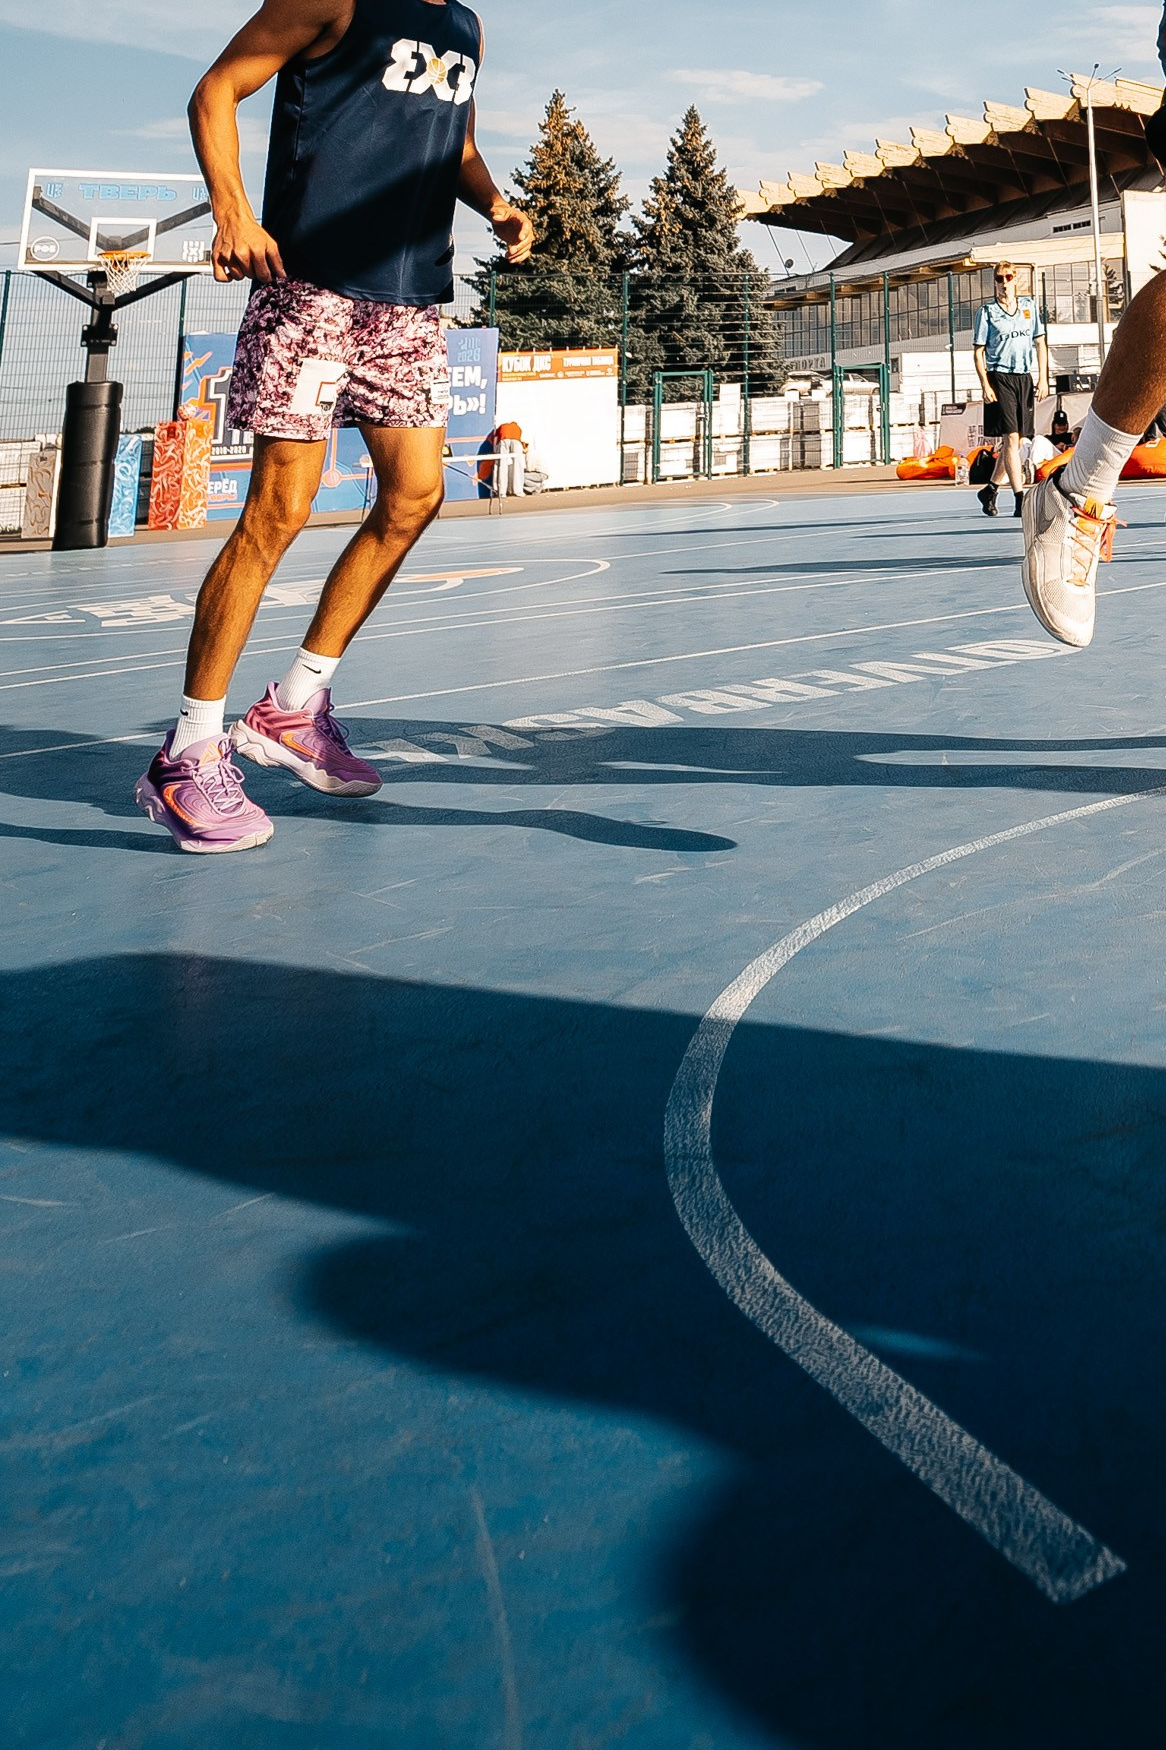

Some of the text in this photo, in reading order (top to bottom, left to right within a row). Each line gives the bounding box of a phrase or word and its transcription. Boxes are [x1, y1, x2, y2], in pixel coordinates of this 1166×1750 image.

[79, 182, 178, 201] ТВЕРЬ
[1011, 328, 1031, 339] DKC
[207, 478, 238, 495] ЕРЁД
